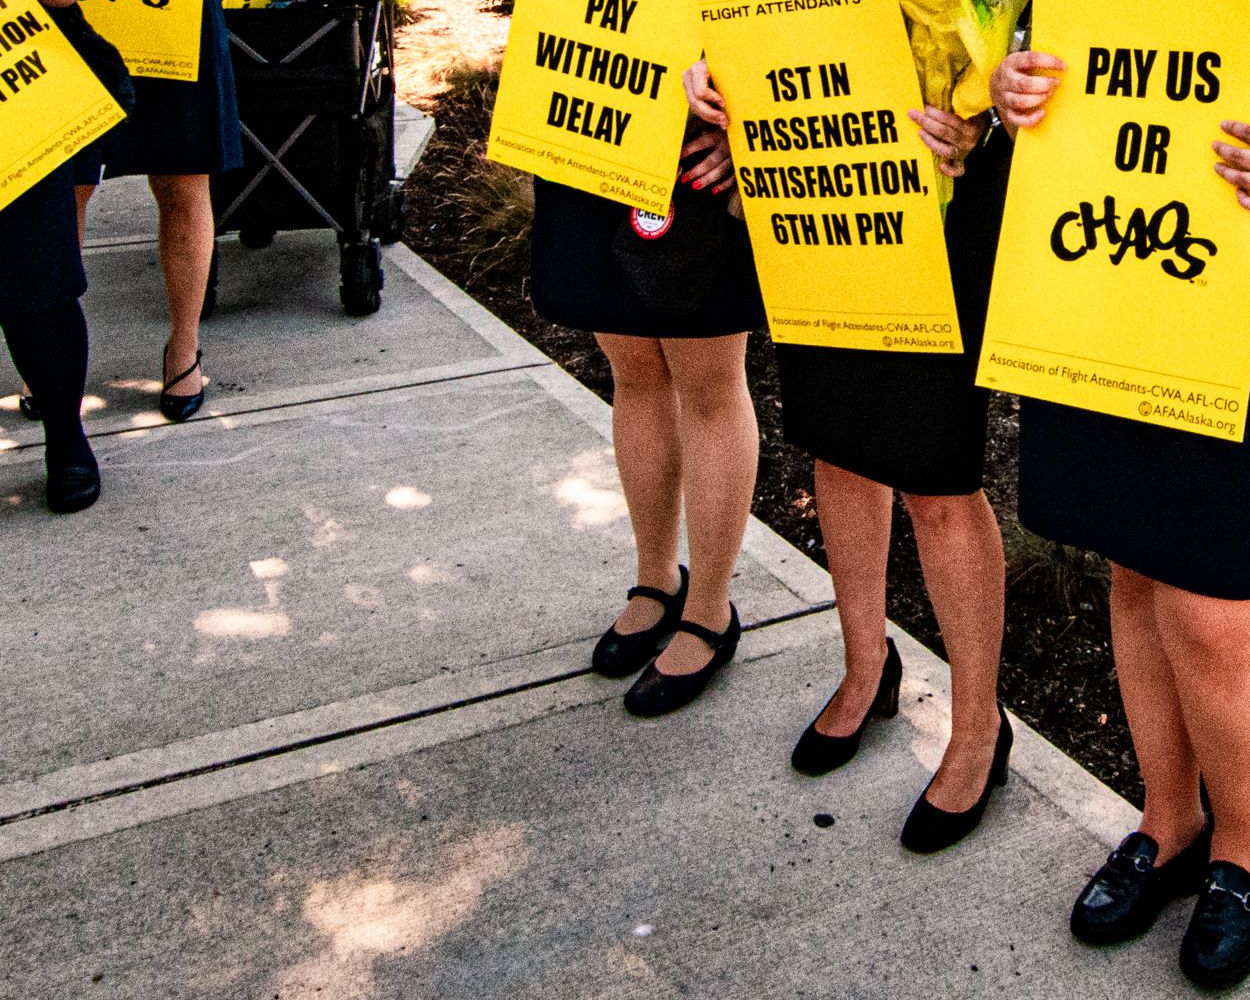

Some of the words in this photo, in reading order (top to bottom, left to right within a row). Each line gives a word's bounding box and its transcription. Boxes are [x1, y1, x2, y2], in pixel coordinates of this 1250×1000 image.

[0, 10, 50, 53] ION,
[701, 5, 750, 22] FLIGHT
[0, 50, 48, 94] PAY
[535, 31, 668, 101] WITHOUT
[766, 66, 811, 102] 1ST
[819, 62, 851, 98] IN
[1085, 47, 1158, 99] PAY
[1165, 50, 1222, 103] US
[547, 91, 632, 147] DELAY
[743, 109, 899, 152] PASSENGER
[495, 136, 535, 155] Association
[537, 147, 546, 157] of
[547, 150, 566, 166] Flight
[1114, 121, 1171, 175] OR
[739, 158, 929, 199] SATISFACTION,
[771, 212, 820, 246] 6TH
[822, 213, 852, 246] IN
[855, 211, 904, 246] PAY
[1050, 195, 1218, 282] CHAOS
[772, 316, 812, 328] Association
[813, 317, 822, 328] of
[822, 319, 842, 332] Flight
[988, 352, 1045, 374] Association
[1048, 364, 1061, 376] of
[1061, 366, 1088, 384] Flight
[1186, 392, 1240, 413] AFL-CIO
